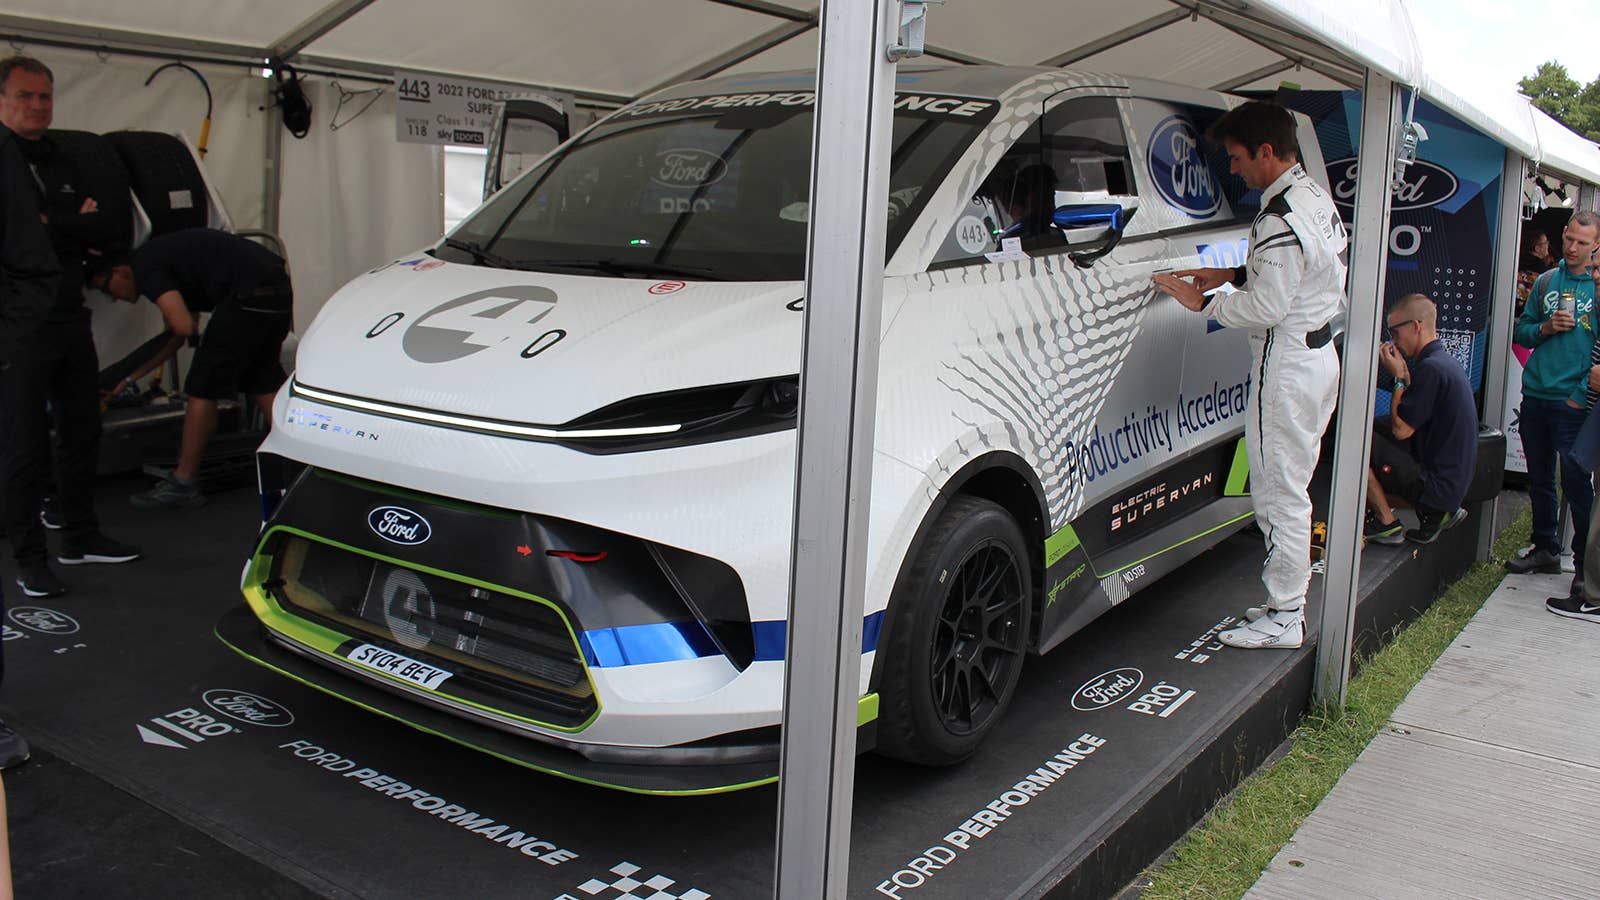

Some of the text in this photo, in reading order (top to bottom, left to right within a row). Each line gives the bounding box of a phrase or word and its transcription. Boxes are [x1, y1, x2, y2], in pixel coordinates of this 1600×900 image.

[398, 78, 430, 98] 443
[437, 83, 464, 97] 2022
[467, 87, 496, 100] FORD
[613, 92, 993, 119] FORD PERFONCE
[408, 124, 428, 137] 118
[436, 114, 461, 126] Class
[464, 117, 475, 126] 14
[437, 129, 453, 141] sky
[660, 153, 712, 181] Ford
[1171, 131, 1217, 206] Ford
[962, 225, 983, 243] 443
[1065, 405, 1173, 493] Productivity
[1111, 483, 1167, 515] ELECTRIC
[1111, 473, 1213, 531] SUPERVAN
[377, 509, 421, 542] Ford
[1122, 564, 1146, 584] NO STEP
[399, 662, 442, 684] BEV
[1081, 673, 1136, 705] Ford
[1127, 684, 1181, 715] PRO
[164, 707, 233, 737] PRO
[212, 695, 280, 721] Ford
[278, 740, 579, 866] FORD PERFORMANCE
[875, 732, 1107, 900] FORD PERFORMANCE
